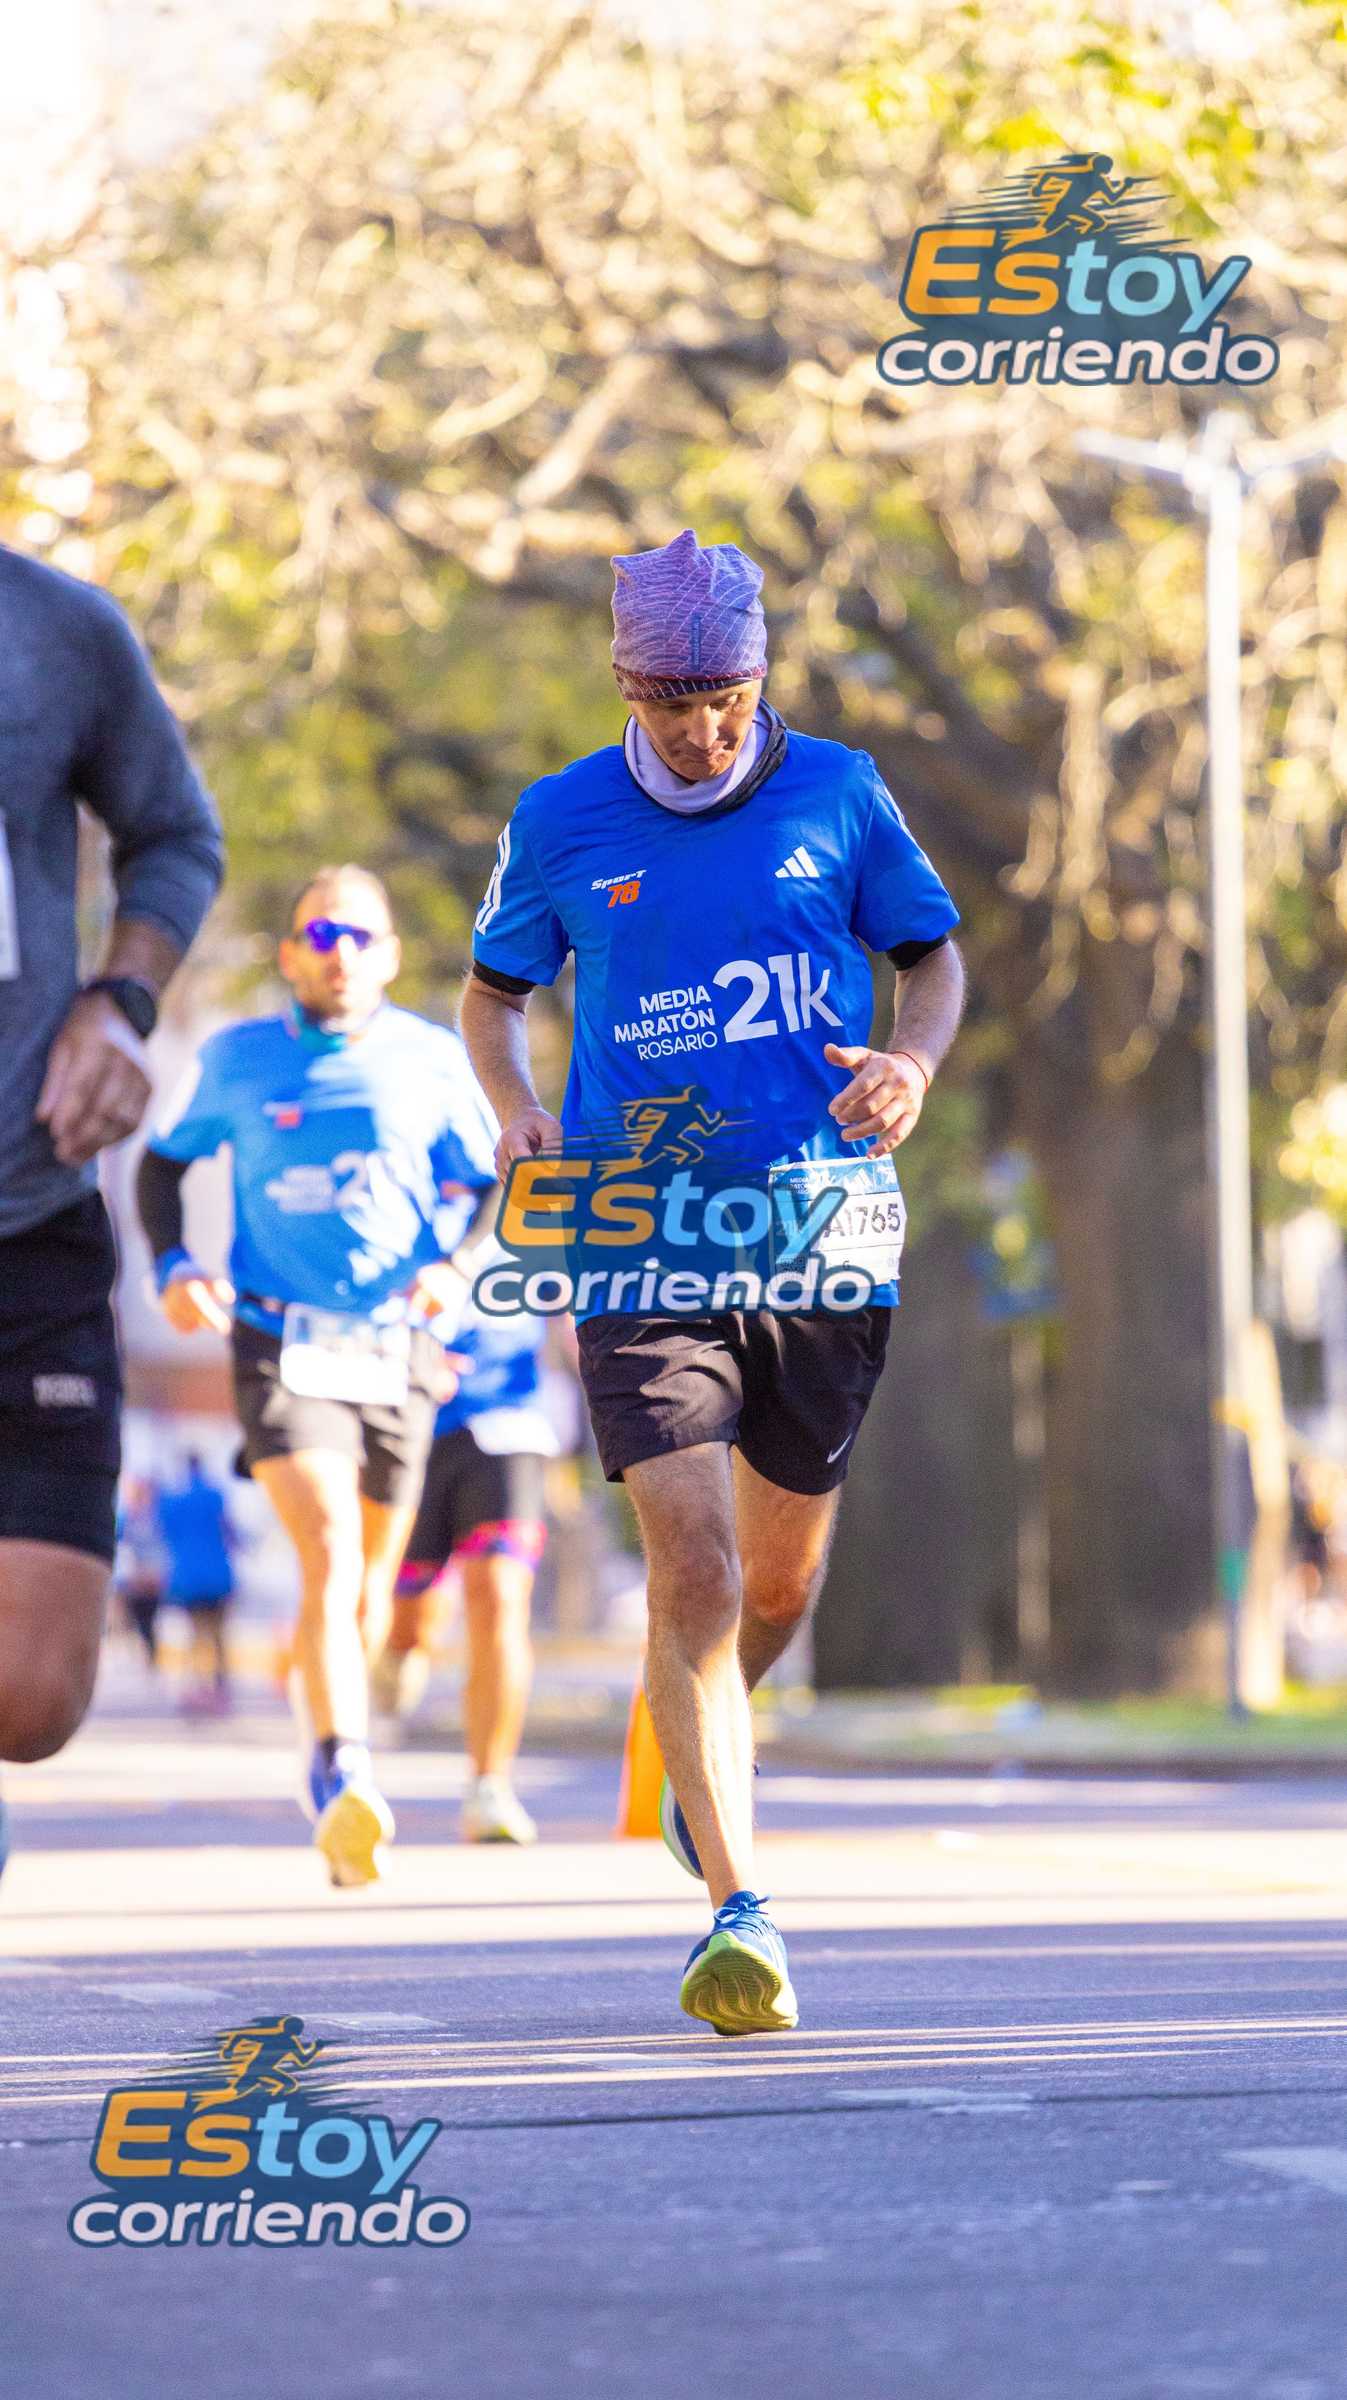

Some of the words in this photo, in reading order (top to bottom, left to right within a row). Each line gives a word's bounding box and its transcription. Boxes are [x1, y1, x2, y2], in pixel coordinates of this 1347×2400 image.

[607, 880, 641, 909] 78
[639, 985, 712, 1015] MEDIA
[614, 1007, 716, 1043] MARATÓN
[637, 1030, 718, 1061] ROSARIO
